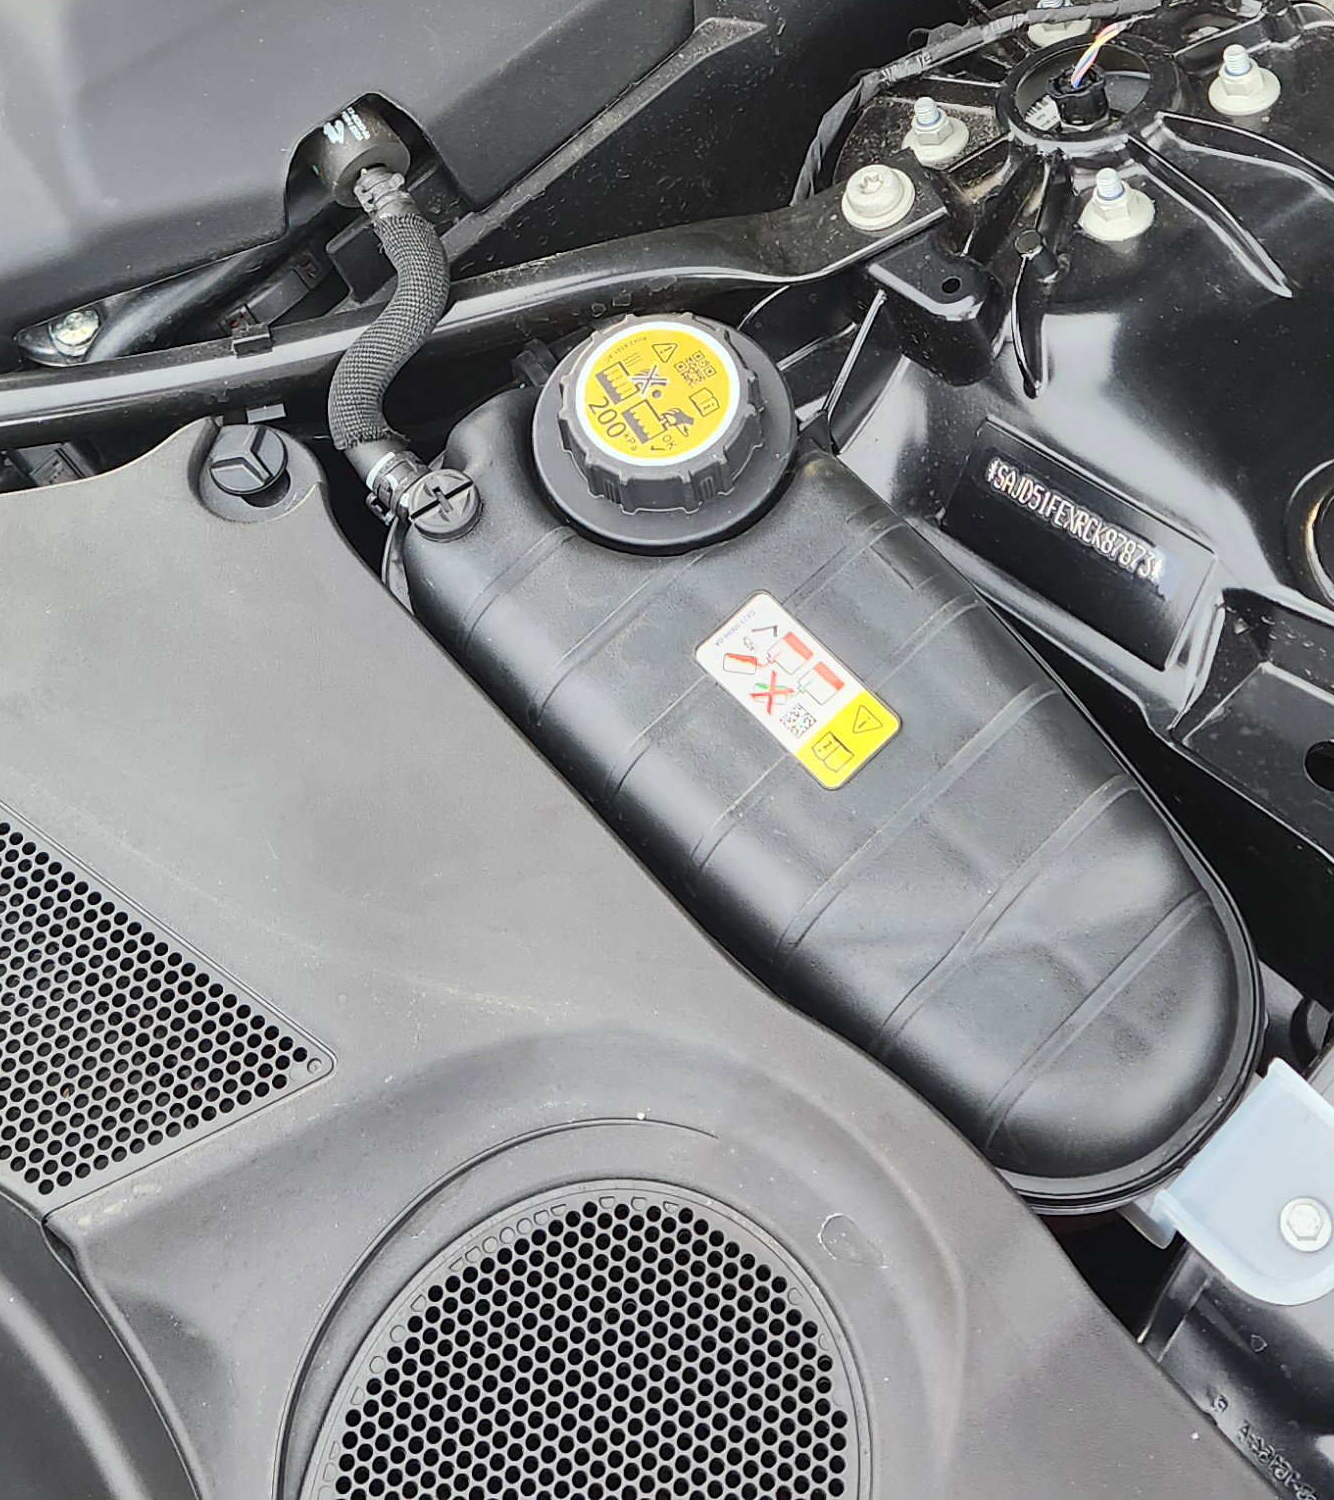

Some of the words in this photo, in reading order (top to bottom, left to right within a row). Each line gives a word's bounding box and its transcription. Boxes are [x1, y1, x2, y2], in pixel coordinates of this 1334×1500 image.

[588, 396, 627, 438] 200
[623, 431, 638, 452] kPa
[662, 434, 677, 450] OK
